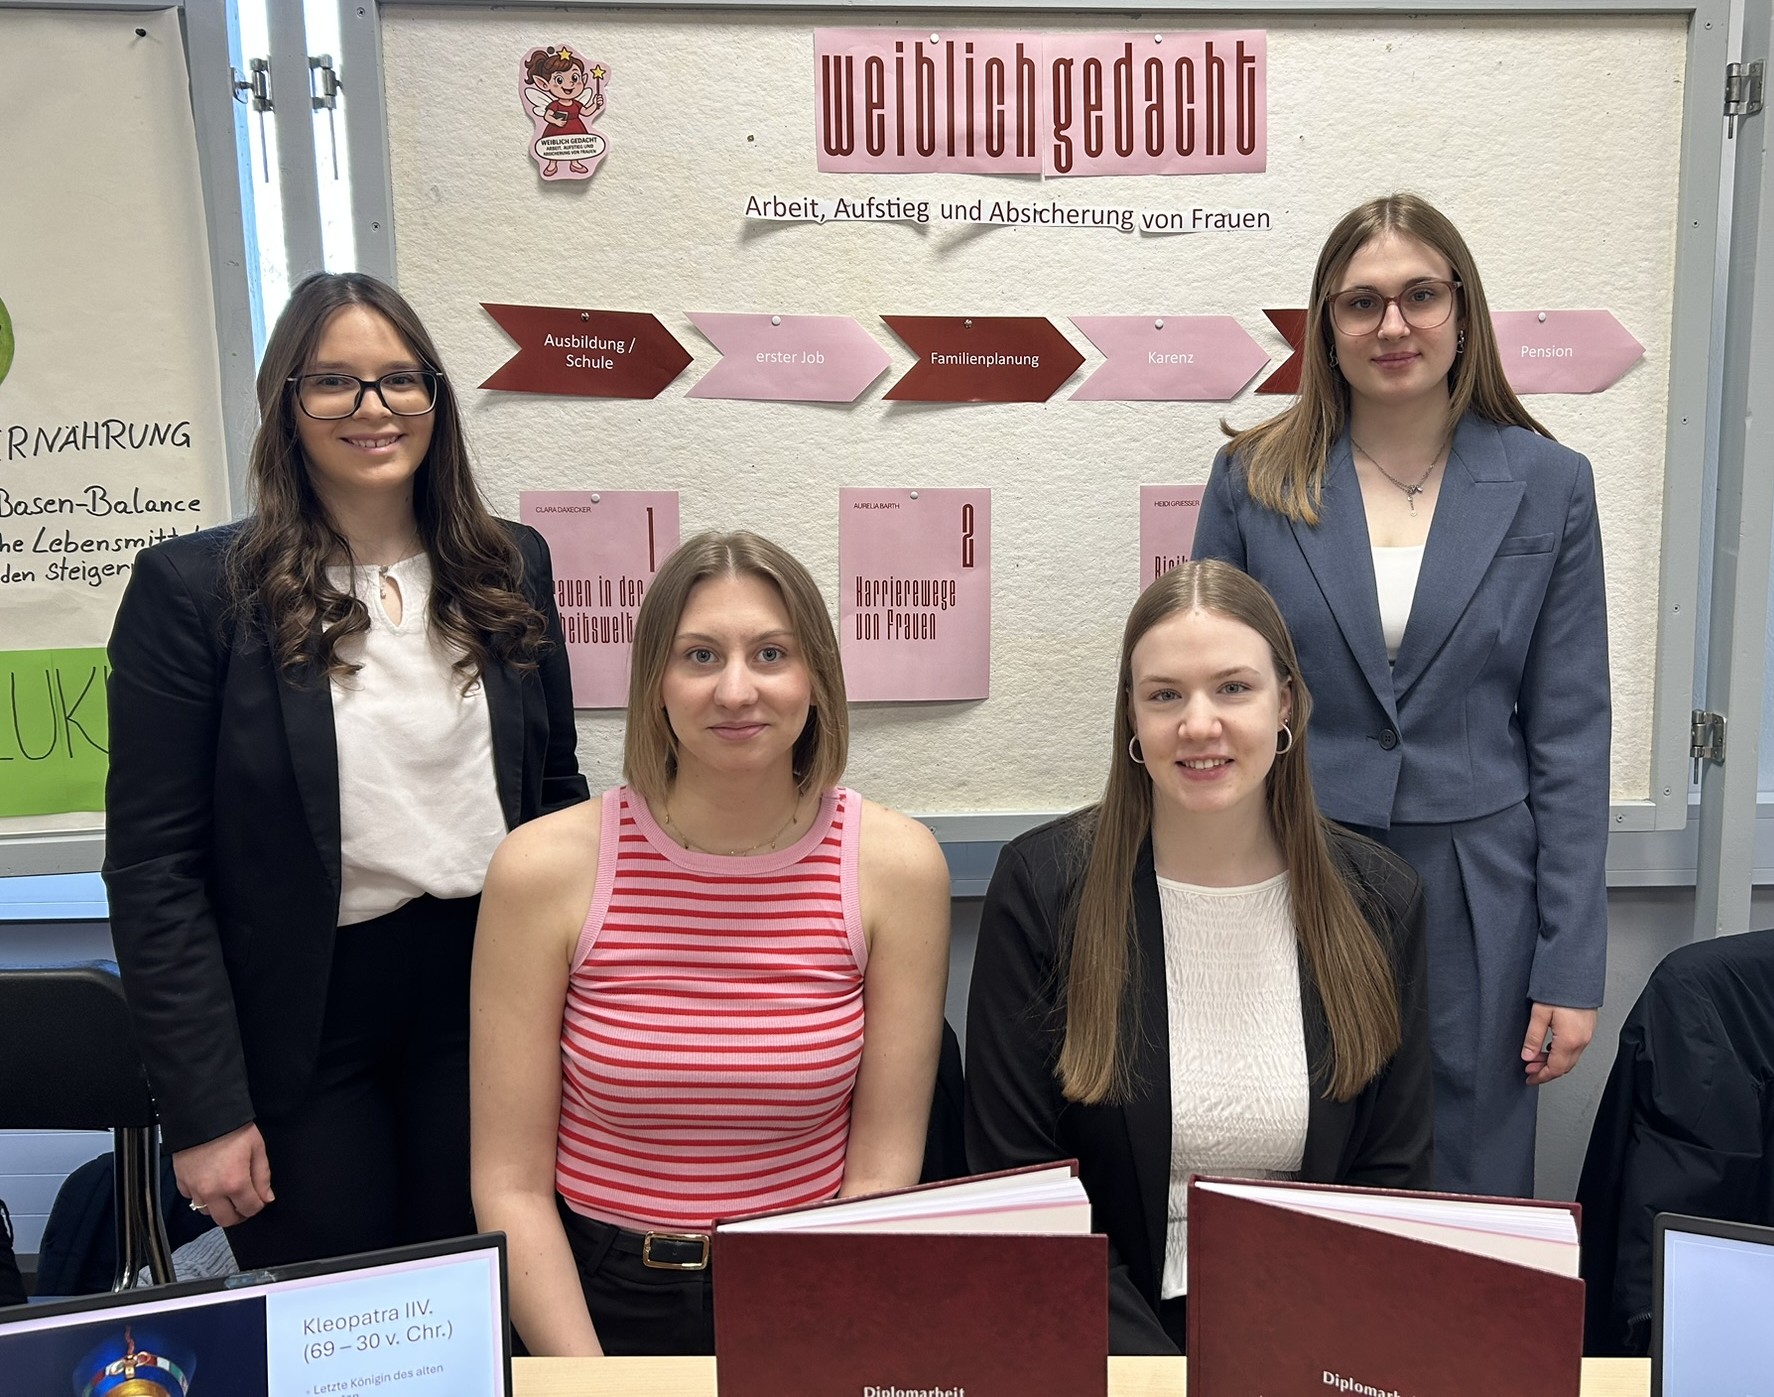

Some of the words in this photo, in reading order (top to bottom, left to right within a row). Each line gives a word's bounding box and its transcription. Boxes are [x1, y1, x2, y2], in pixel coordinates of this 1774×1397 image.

[822, 40, 1036, 158] weiblich
[1053, 40, 1256, 174] gedacht
[541, 138, 570, 146] WEIBLICH
[570, 137, 598, 145] GEDACHT
[745, 195, 826, 222] Arbeit,
[833, 197, 930, 223] Aufstieg
[940, 199, 982, 221] und
[989, 200, 1134, 230] Absicherung
[1142, 212, 1183, 229] von
[1192, 208, 1270, 229] Frauen
[544, 333, 625, 353] Ausbildung
[756, 350, 797, 364] erster
[801, 350, 825, 364] Job
[1148, 351, 1194, 364] Karenz
[1521, 344, 1573, 358] Pension
[566, 354, 614, 369] Schule
[930, 352, 1040, 368] Familienplanung
[0, 419, 191, 460] RNÄHRUNG
[32, 525, 200, 553] Lebensmitt
[647, 507, 655, 572] 1
[962, 503, 974, 568] 2
[552, 579, 592, 607] auen
[599, 575, 612, 607] in
[619, 575, 644, 607] der
[856, 575, 956, 611] Karrierewege
[856, 613, 880, 640] von
[887, 609, 936, 640] Frauen
[0, 665, 110, 760] UK
[303, 1307, 399, 1336] Kleopatra
[405, 1298, 433, 1318] IIV.
[303, 1340, 335, 1364] (69
[356, 1332, 380, 1351] 30
[385, 1333, 400, 1346] v.
[406, 1319, 453, 1342] Chr.)
[313, 1381, 348, 1395] Letzte
[350, 1371, 391, 1389] Königin
[393, 1369, 414, 1381] des
[415, 1364, 444, 1377] alten
